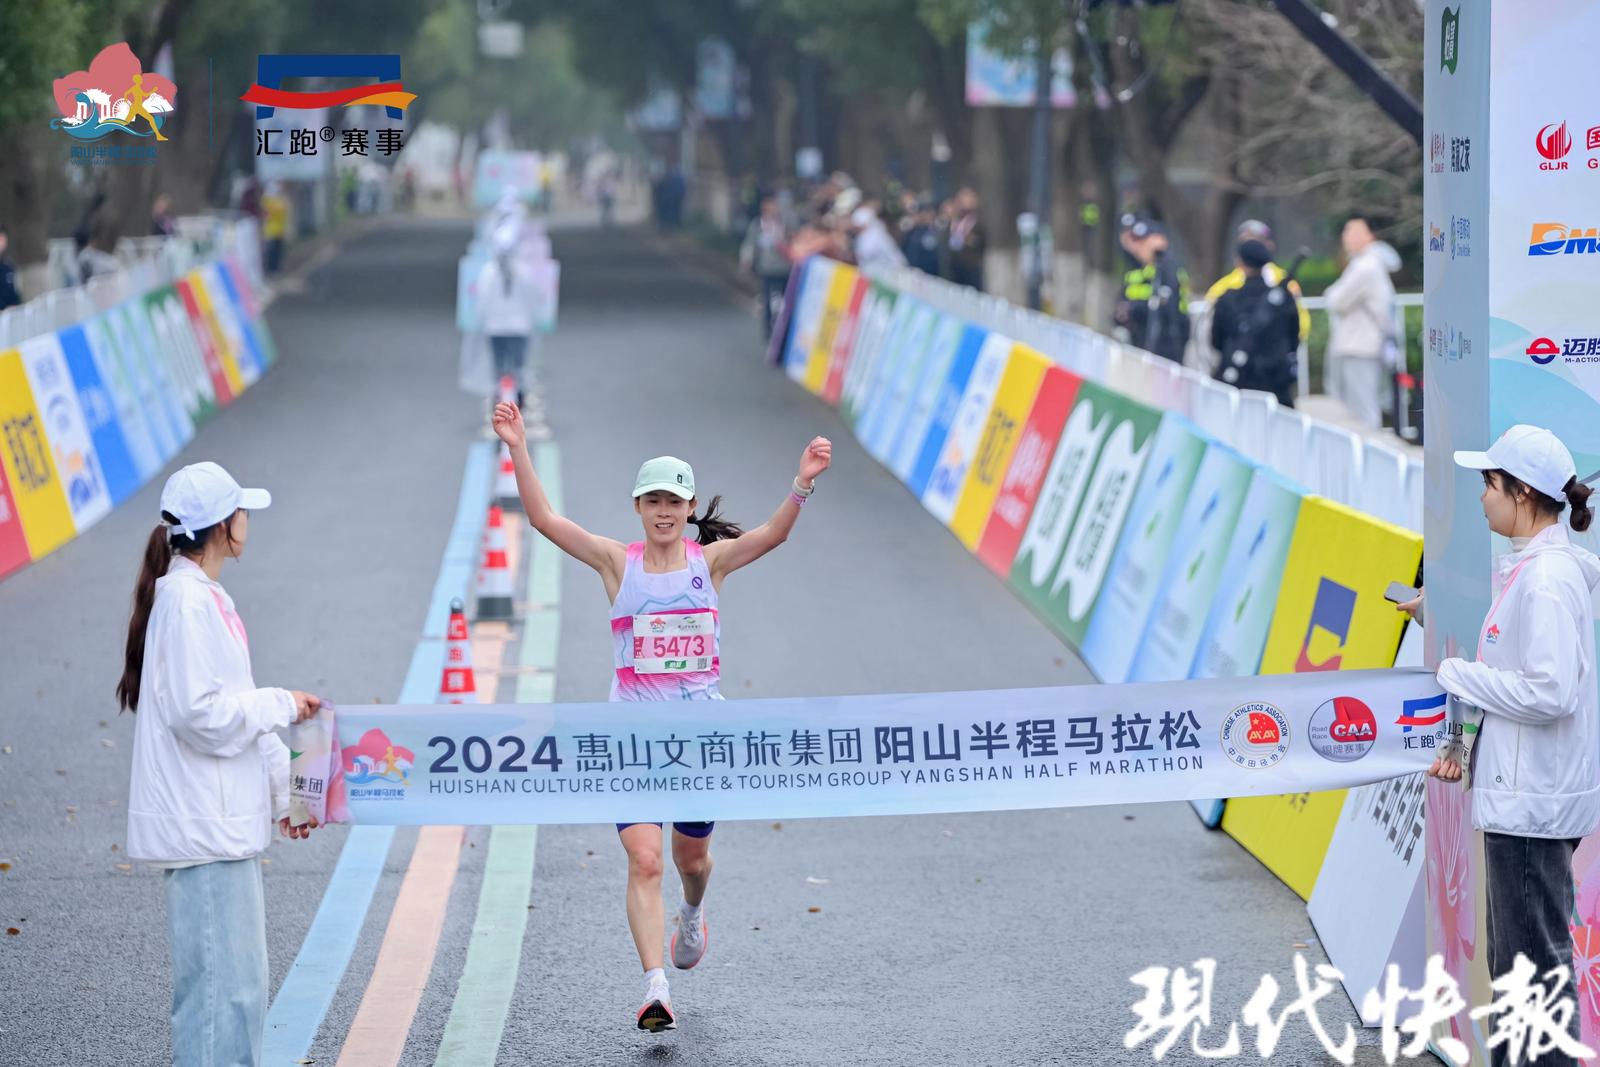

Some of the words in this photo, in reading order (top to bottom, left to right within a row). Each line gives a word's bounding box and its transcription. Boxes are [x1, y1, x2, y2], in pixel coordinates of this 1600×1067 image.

[1539, 162, 1568, 171] GLJR
[653, 635, 705, 658] 5473
[1222, 716, 1236, 740] CHINESE
[1234, 704, 1264, 719] ATHLETICS
[1264, 706, 1288, 737] ASSOCIATION
[1334, 722, 1373, 738] CAA
[428, 735, 563, 773] 2024
[572, 727, 863, 773] 惠山文商旅集团
[874, 710, 1203, 765] 阳山半程马拉松
[290, 773, 323, 794] 集团
[429, 778, 516, 794] HUISHAN
[521, 777, 605, 793] CULTURE
[610, 775, 715, 792] COMMERCE
[719, 776, 733, 789] &
[736, 772, 822, 790] TOURISM
[827, 770, 893, 787] GROUP
[900, 765, 1013, 784] YANGSHAN
[1023, 762, 1079, 779] HALF
[1089, 755, 1204, 775] MARATHON
